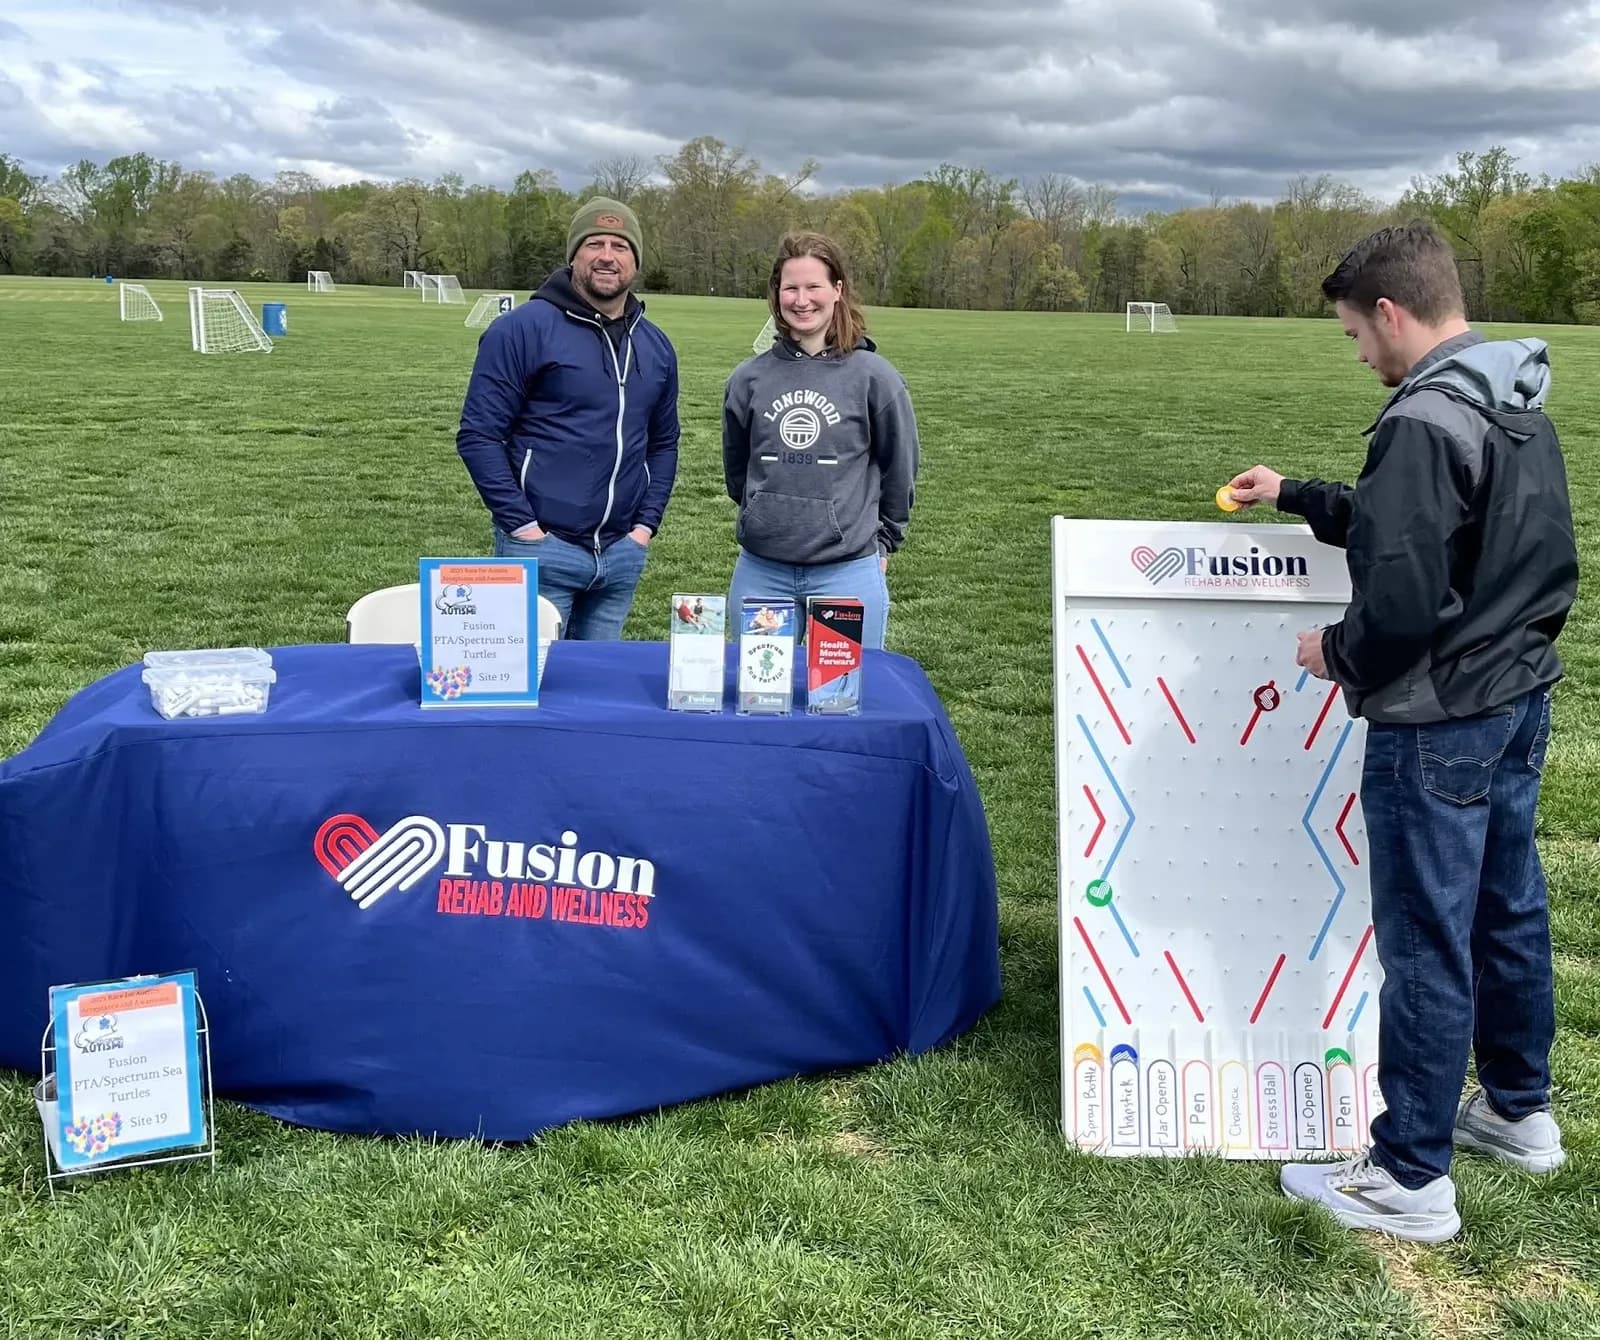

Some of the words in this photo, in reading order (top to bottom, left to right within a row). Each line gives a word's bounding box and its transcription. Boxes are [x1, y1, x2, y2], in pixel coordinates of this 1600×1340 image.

[764, 389, 841, 427] LONGWOOD
[782, 452, 813, 465] 1839
[1184, 547, 1309, 576] Fusion
[1184, 577, 1222, 587] REHAB
[1224, 578, 1248, 587] AND
[1252, 578, 1310, 588] WELLNESS
[463, 621, 496, 631] Fusion
[434, 636, 505, 647] PTA/Spectrum
[508, 635, 524, 644] Sea
[820, 640, 850, 649] Health
[463, 650, 497, 659] Turtles
[818, 657, 856, 665] Forward
[819, 649, 852, 659] Moving
[478, 672, 497, 682] Site
[500, 672, 510, 682] 19
[443, 823, 656, 898] Fusion
[437, 879, 504, 916] REHAB
[505, 883, 547, 919] AND
[551, 886, 649, 929] WELLNESS
[108, 1054, 148, 1069] Fusion
[74, 1069, 160, 1092] PTA/Spectrum
[162, 1066, 183, 1077] Sea
[1083, 1066, 1097, 1099] Bottle
[1264, 1074, 1277, 1096] Ball
[108, 1088, 151, 1103] Turtles
[1155, 1069, 1170, 1116] Opener
[1302, 1072, 1317, 1119] Opener
[1118, 1078, 1136, 1136] Chapstick
[1189, 1092, 1207, 1125] Pen
[1335, 1095, 1352, 1128] Pen
[130, 1115, 153, 1128] Site
[155, 1112, 168, 1124] 19
[1083, 1103, 1100, 1139] Spray
[1157, 1120, 1169, 1138] Jar
[1266, 1099, 1278, 1139] Stress
[1304, 1123, 1317, 1141] Jar
